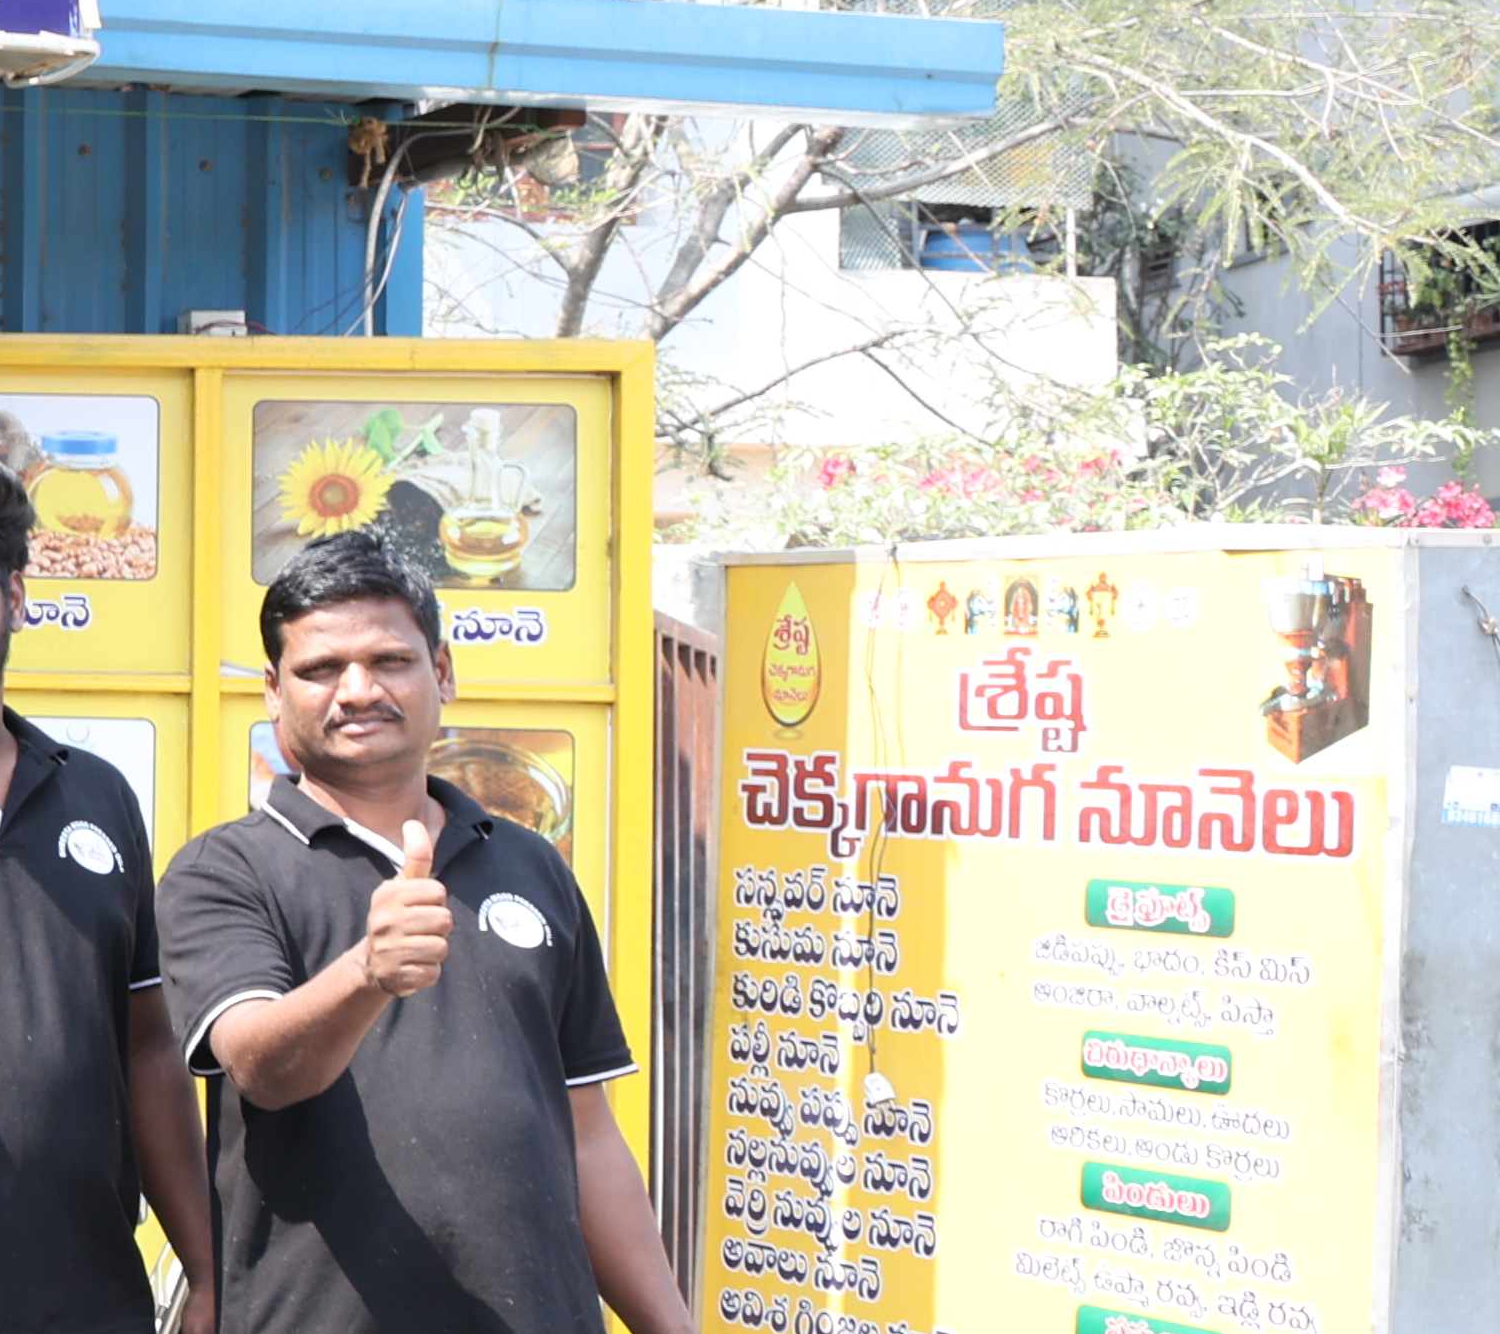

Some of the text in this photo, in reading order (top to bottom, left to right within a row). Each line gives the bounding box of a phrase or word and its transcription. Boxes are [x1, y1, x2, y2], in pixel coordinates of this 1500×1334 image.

[453, 610, 544, 642] నూనె
[740, 753, 1354, 858] చెక్కగానుగ నూనెలు
[833, 875, 899, 917] నూనె
[734, 922, 898, 972] కుసుమ నూనె
[809, 979, 884, 1042] కొబ్బరి
[891, 991, 960, 1034] నూనె
[777, 1031, 840, 1075] నూనె
[863, 1153, 931, 1199] నూనె
[1103, 1172, 1209, 1217] పిండులు
[869, 1209, 937, 1255] నూనె
[814, 1254, 880, 1300] నూనె
